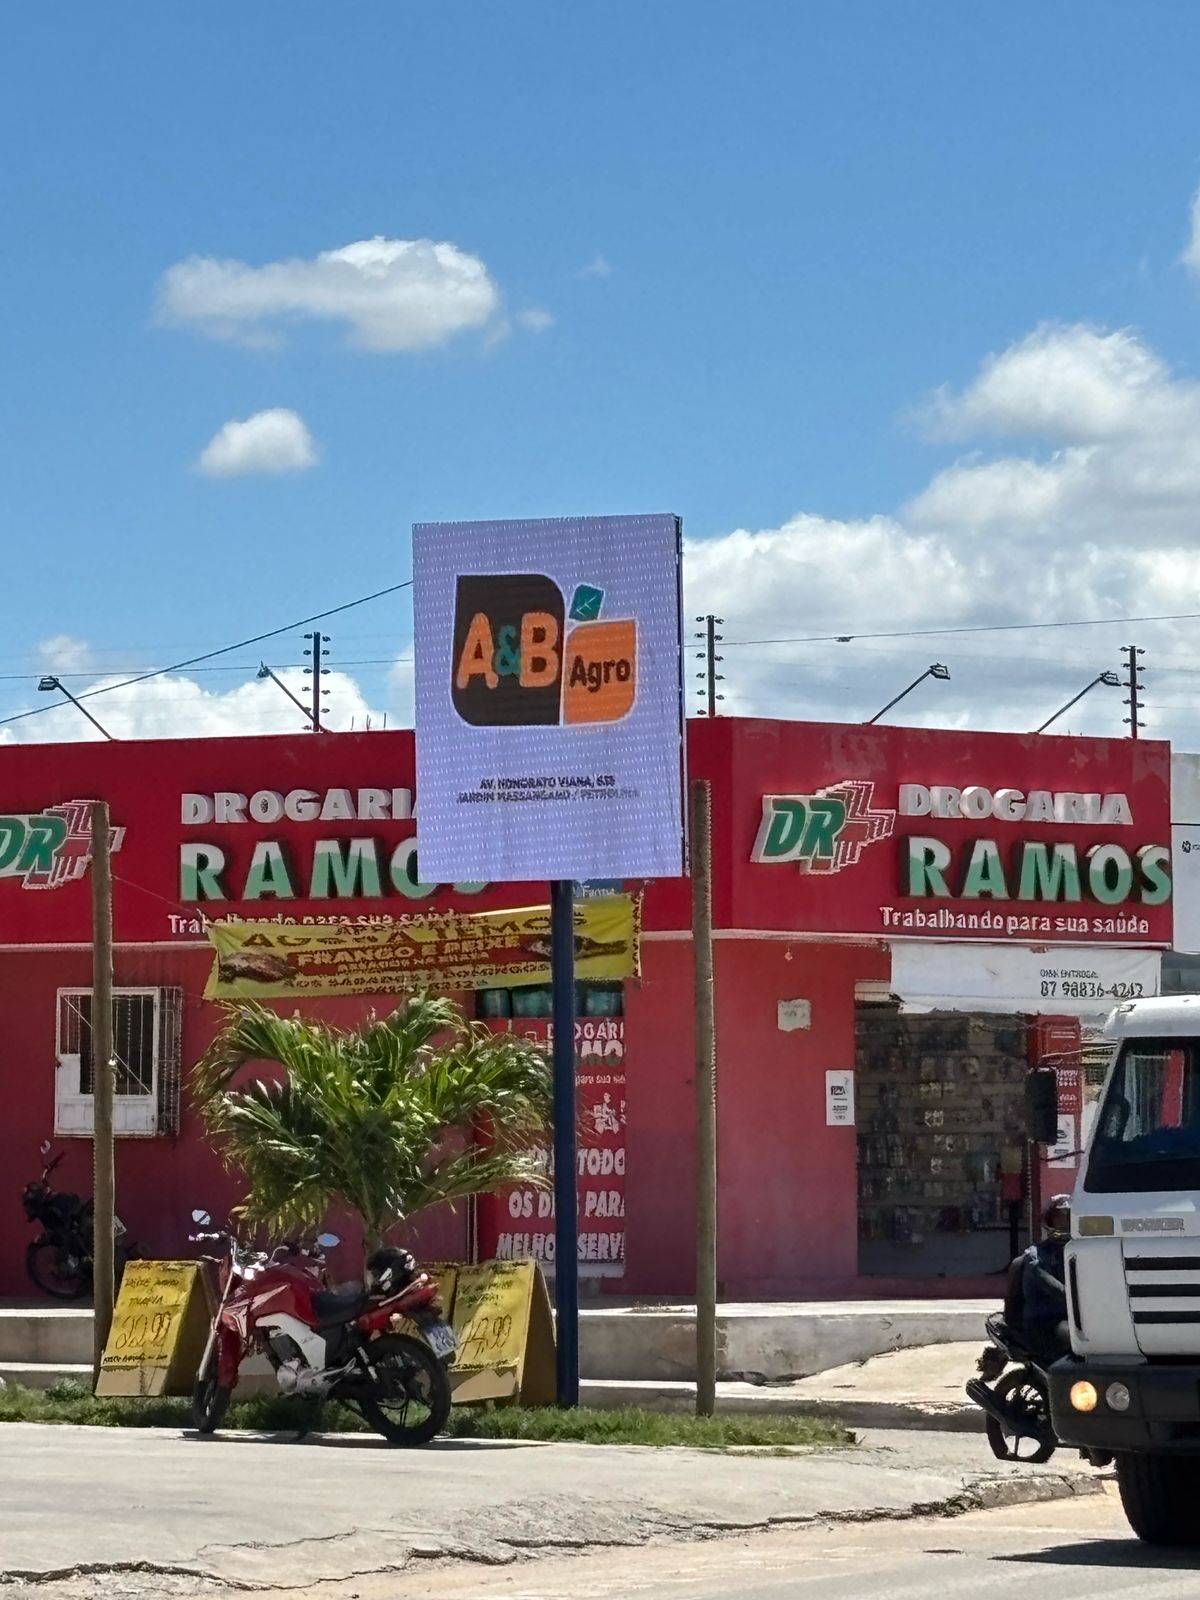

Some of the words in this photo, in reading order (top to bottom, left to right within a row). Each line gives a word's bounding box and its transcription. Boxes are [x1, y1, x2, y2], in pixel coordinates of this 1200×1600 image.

[456, 611, 559, 689] A&B
[569, 655, 631, 692] Agro
[180, 788, 417, 824] DROGARI
[899, 783, 1134, 825] DROGARIA
[761, 798, 847, 859] DR
[907, 836, 1172, 905] RAMOS
[880, 906, 1003, 929] Trabalhando
[1006, 915, 1051, 934] para
[1055, 918, 1089, 932] sua
[1092, 911, 1149, 933] saúde
[297, 946, 415, 966] FRANGO
[508, 1191, 533, 1218] OS
